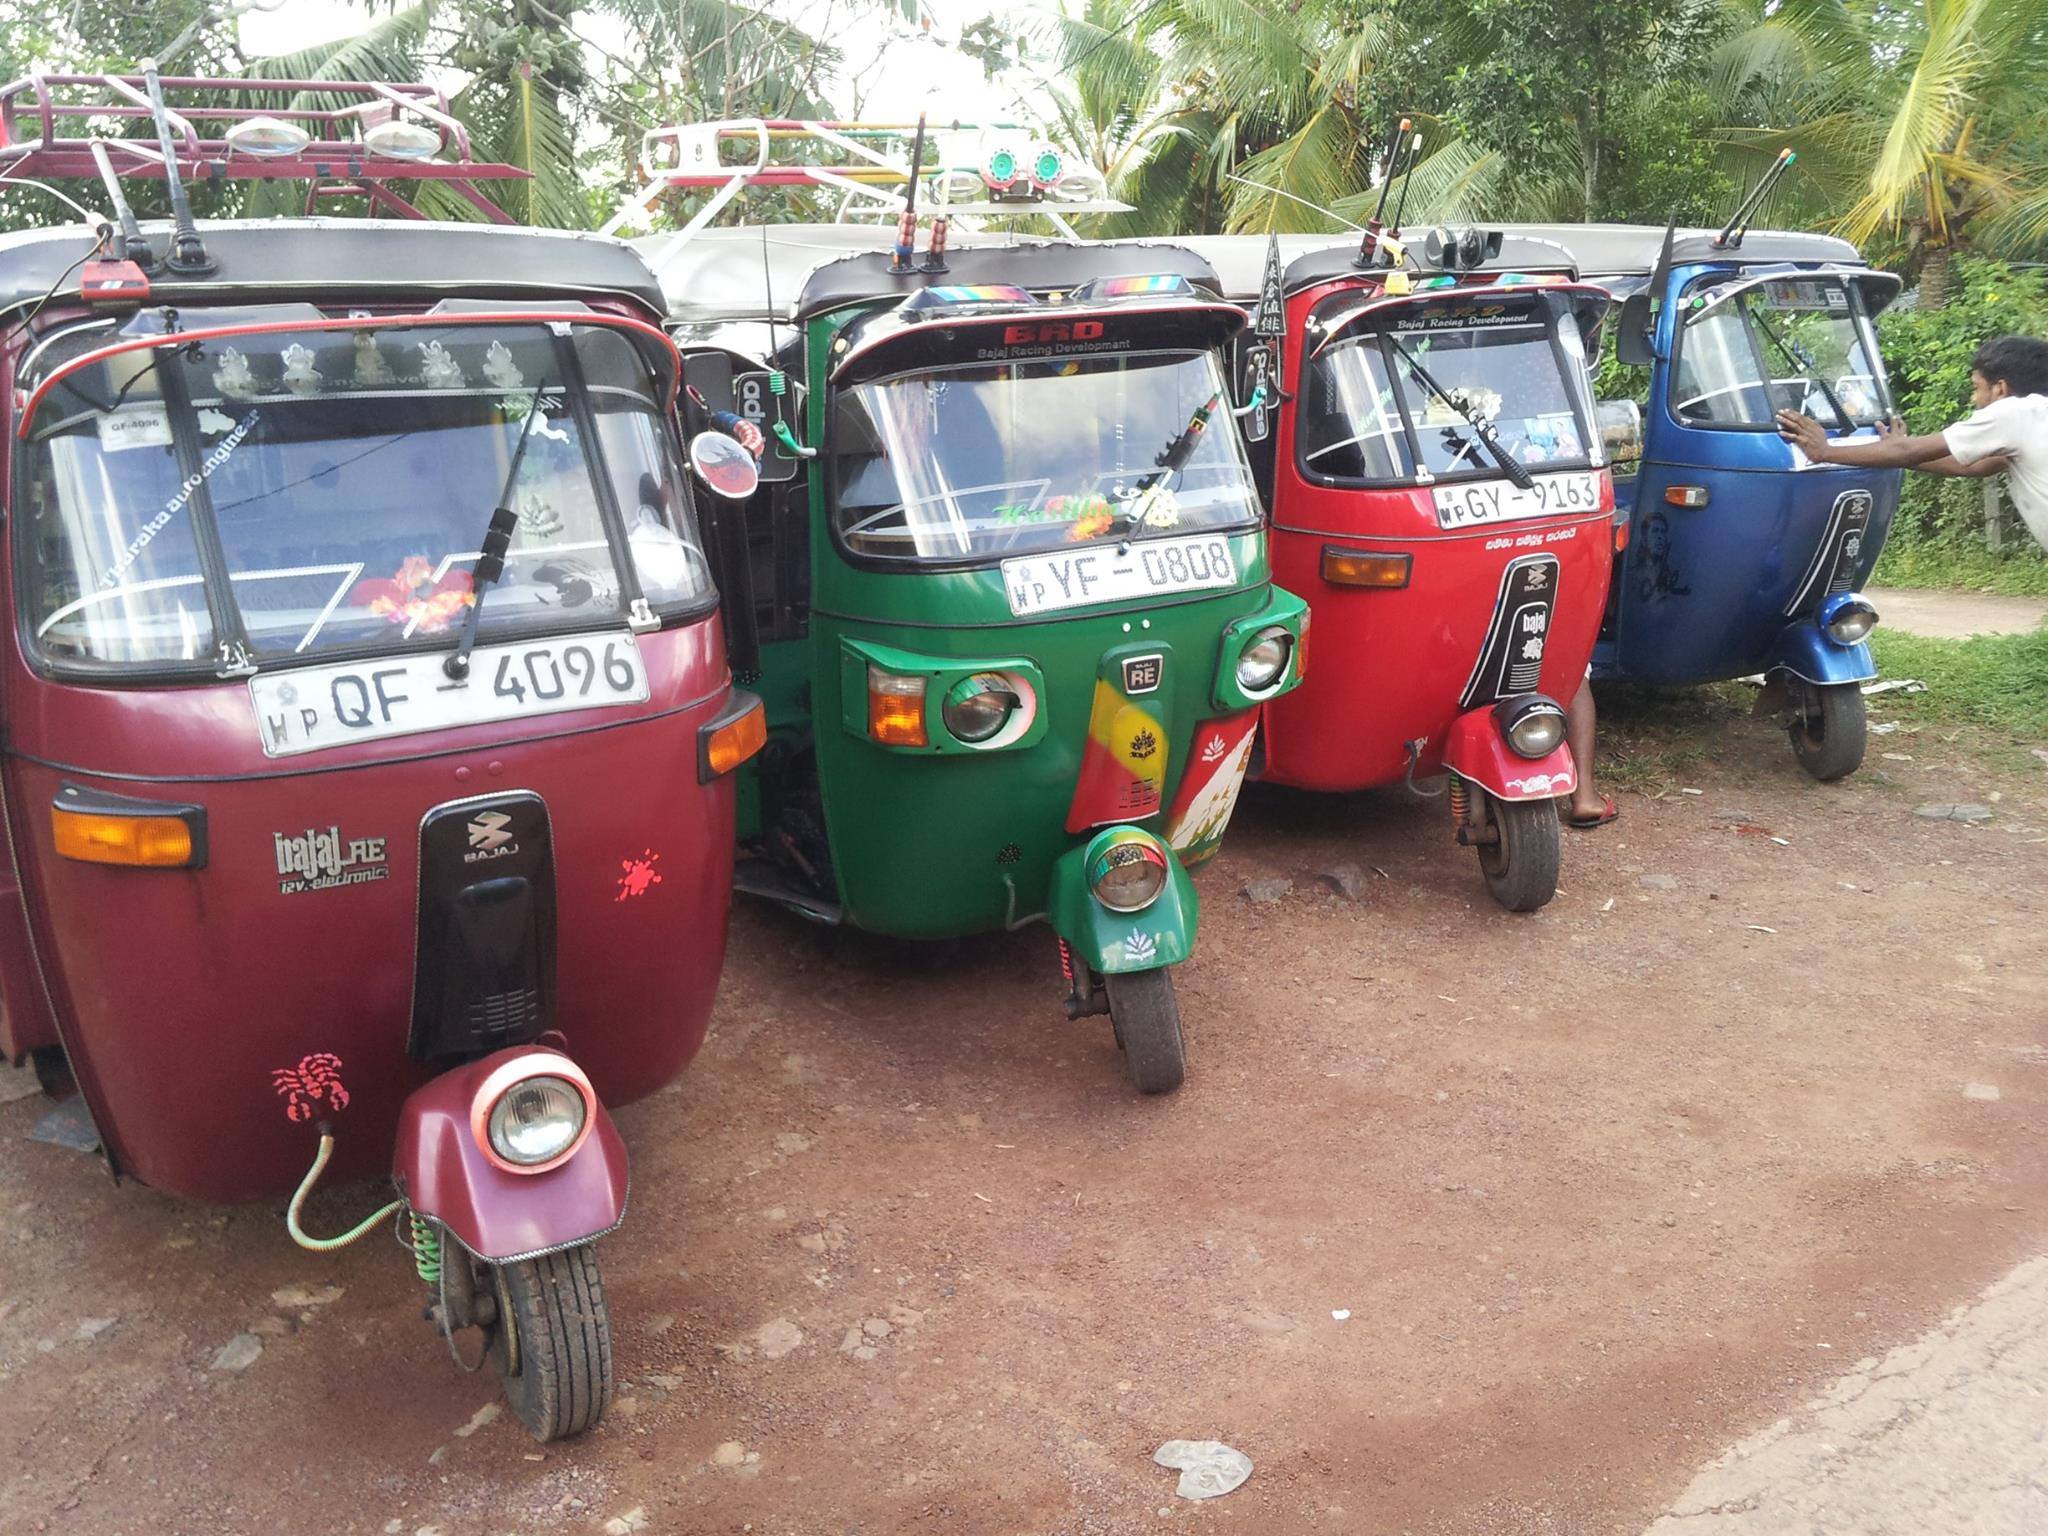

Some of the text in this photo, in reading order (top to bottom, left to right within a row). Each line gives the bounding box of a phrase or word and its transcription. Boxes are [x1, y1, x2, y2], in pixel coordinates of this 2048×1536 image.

[1397, 314, 1529, 330] Bajaj Racing Development
[977, 339, 1131, 359] Bajaj Racing Development
[1523, 583, 1548, 592] BAJAJ
[1523, 610, 1546, 635] bajaj
[1131, 667, 1155, 687] RE
[274, 826, 341, 880] bajaj
[464, 843, 520, 863] BAJAJ
